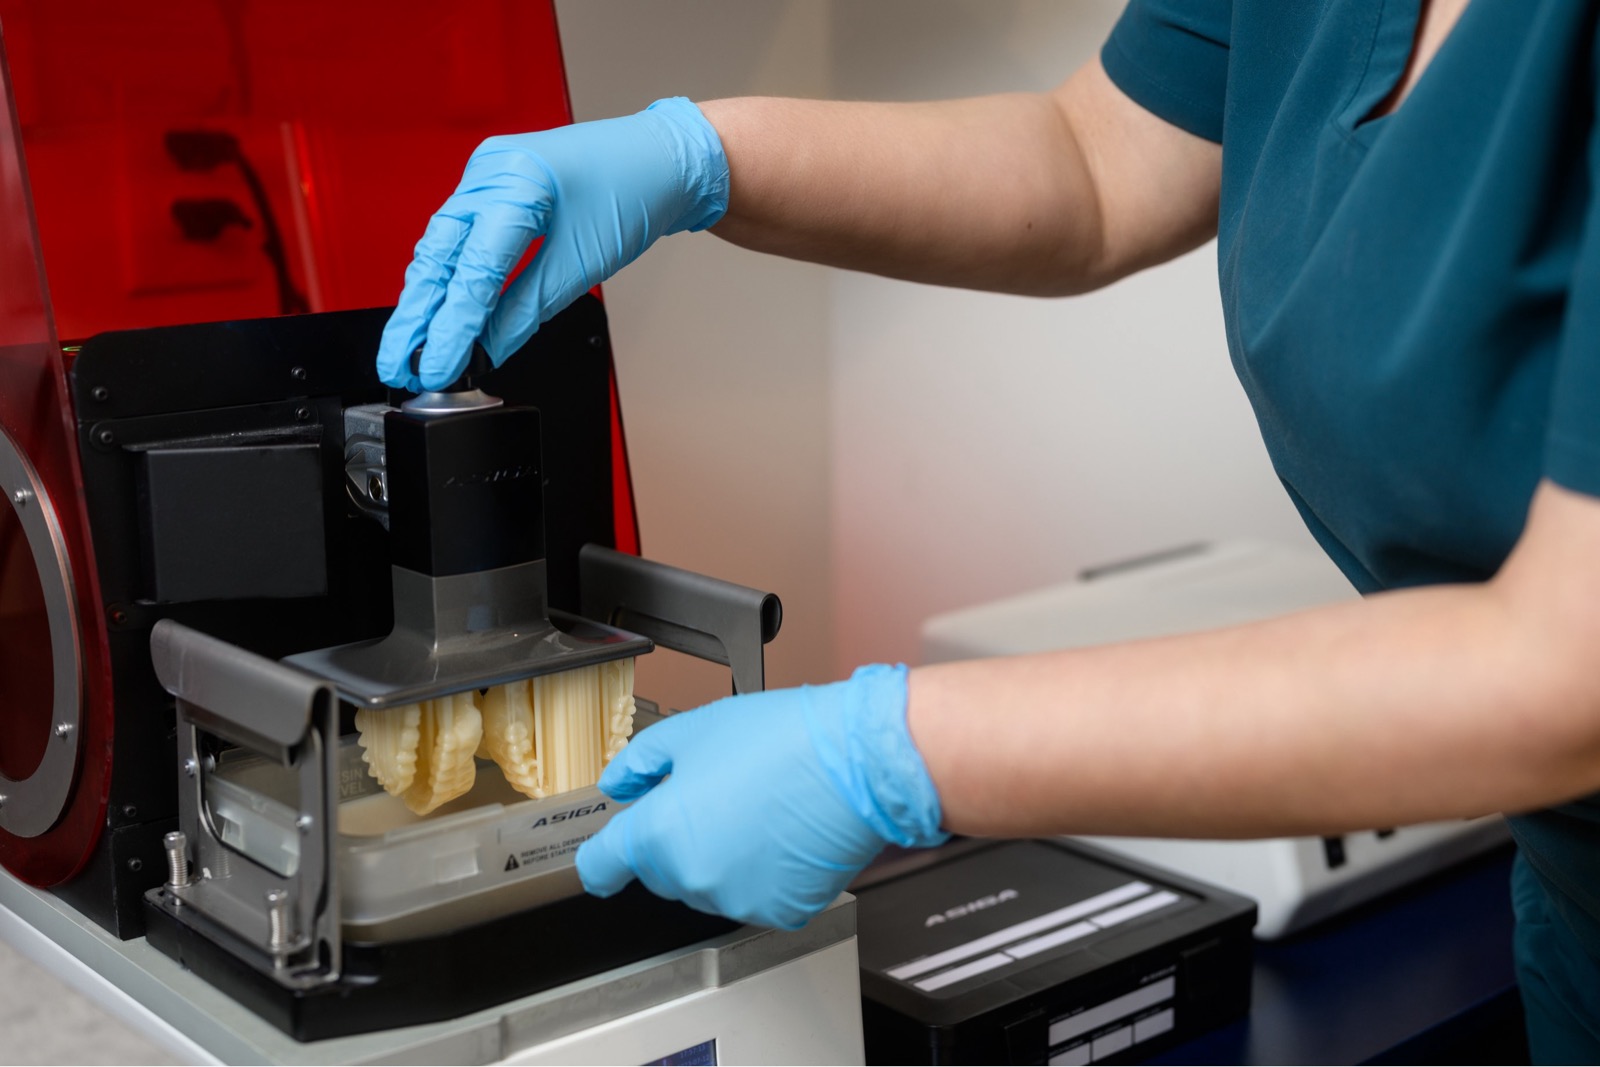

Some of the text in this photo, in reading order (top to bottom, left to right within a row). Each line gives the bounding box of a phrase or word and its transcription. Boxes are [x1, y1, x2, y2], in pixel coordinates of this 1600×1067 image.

[341, 768, 363, 783] SIN
[340, 781, 366, 797] VEL
[532, 802, 608, 829] ASIGA
[521, 847, 547, 857] REMOVE
[549, 843, 561, 851] ALL
[562, 835, 586, 847] DEBRIS
[523, 843, 581, 865] BEFORE STARTIN
